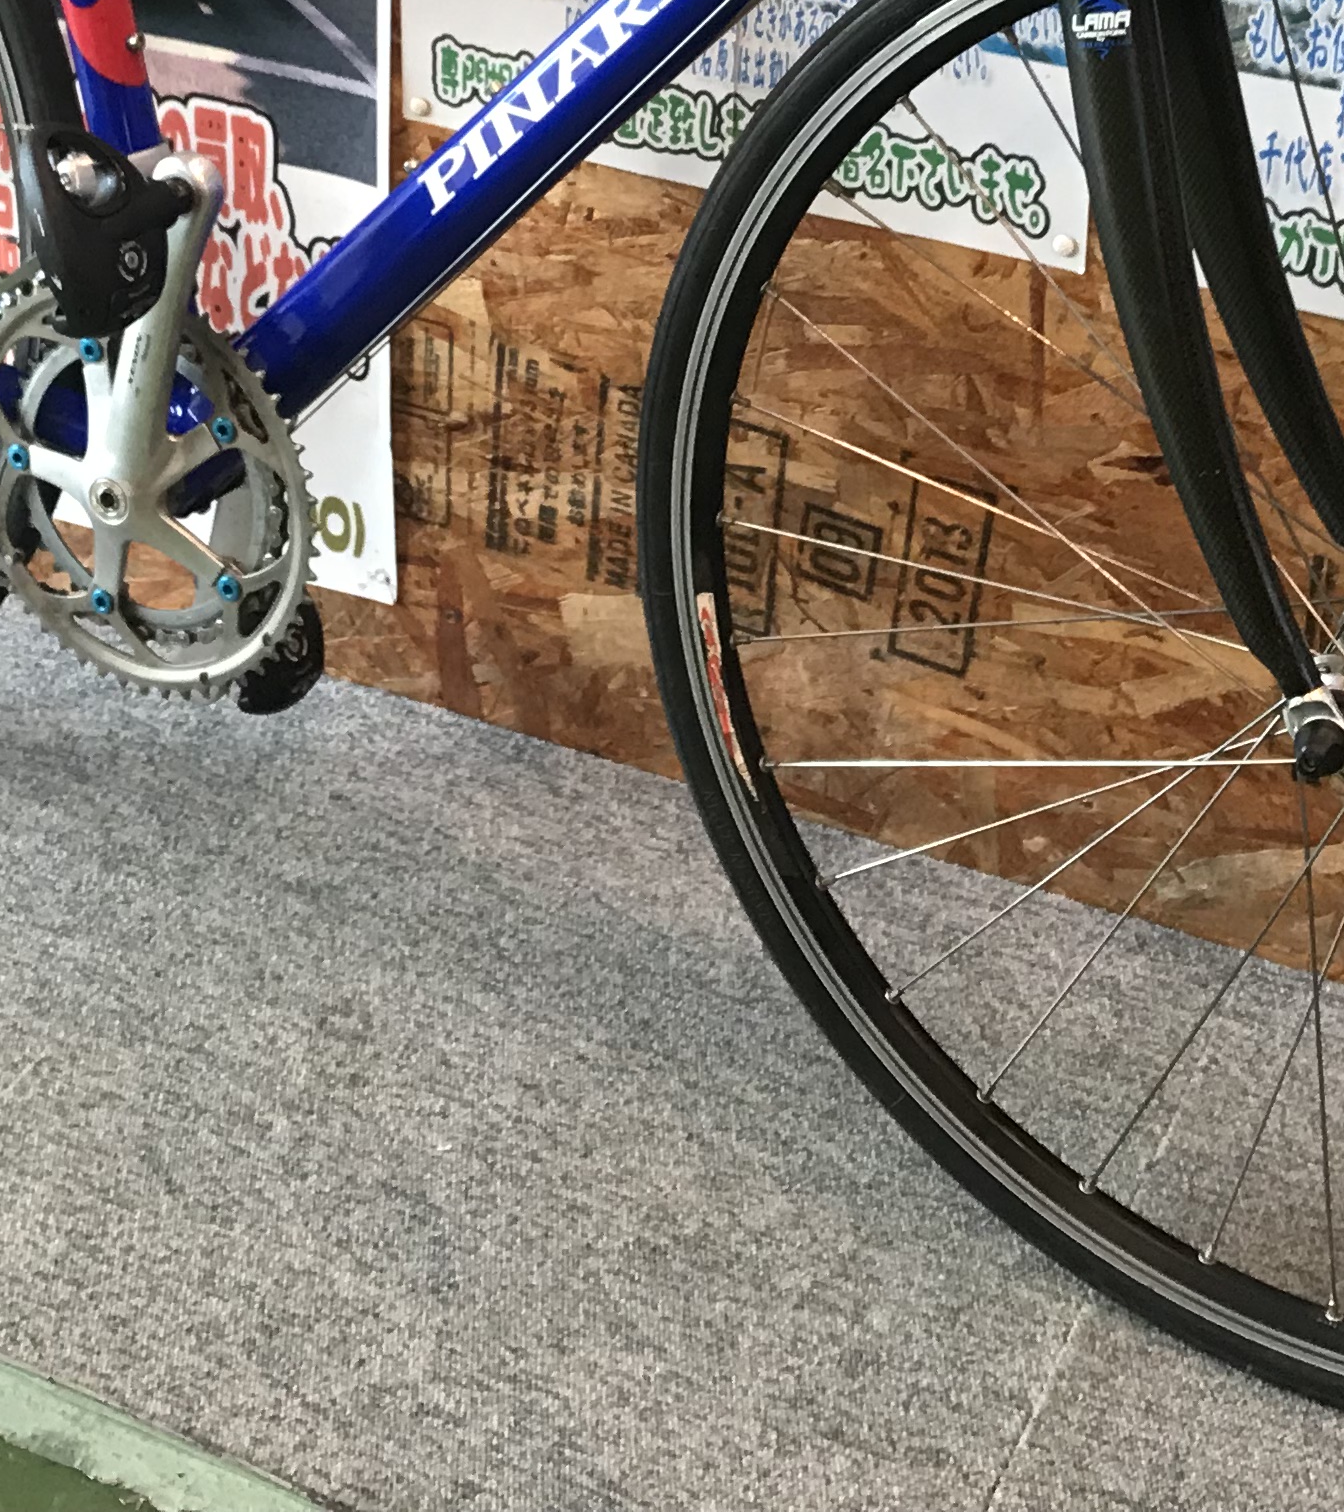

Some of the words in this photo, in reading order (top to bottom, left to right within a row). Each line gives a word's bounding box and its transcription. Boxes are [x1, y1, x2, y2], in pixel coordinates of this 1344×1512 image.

[1072, 9, 1131, 32] LAMA
[810, 520, 862, 584] 09
[910, 517, 972, 635] 2013
